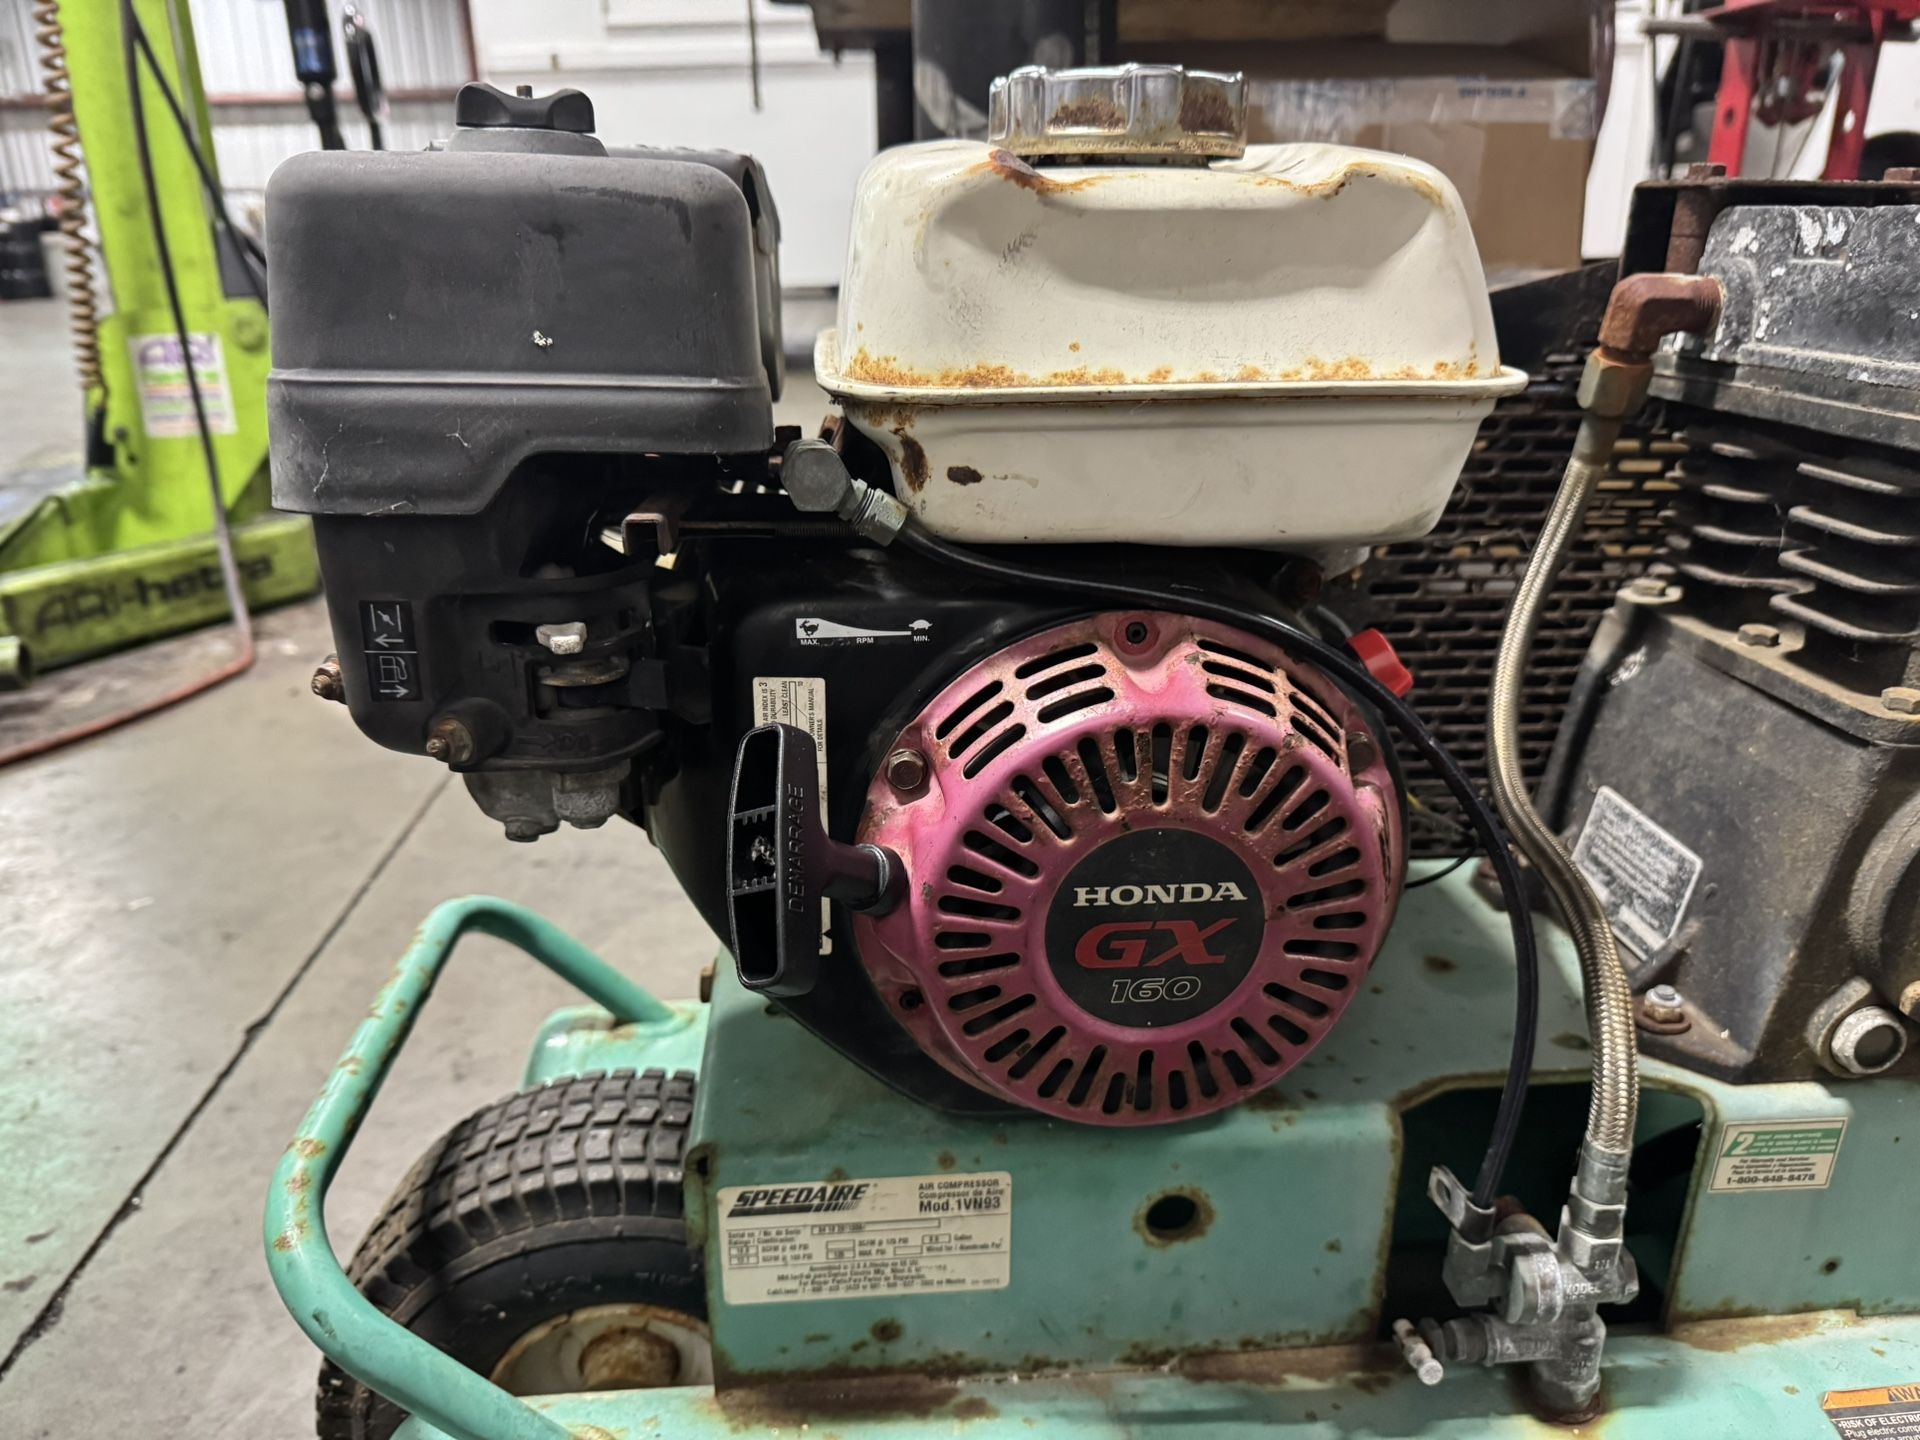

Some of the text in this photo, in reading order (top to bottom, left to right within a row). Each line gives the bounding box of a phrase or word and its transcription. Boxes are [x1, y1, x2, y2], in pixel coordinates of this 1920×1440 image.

[35, 555, 273, 633] ARI-heta
[1073, 882, 1248, 907] HONDA
[1075, 918, 1239, 969] GX
[1110, 976, 1201, 1003] 160
[1731, 1133, 1755, 1155] 2
[733, 1183, 870, 1207] SPEEDAIRE
[918, 1178, 1000, 1191] AIR COMPRESSOR
[918, 1190, 970, 1199] Compressor
[986, 1188, 1004, 1196] Aire
[1864, 1417, 1878, 1427] OF
[1867, 1426, 1897, 1436] electric
[1897, 1424, 1920, 1434] comp
